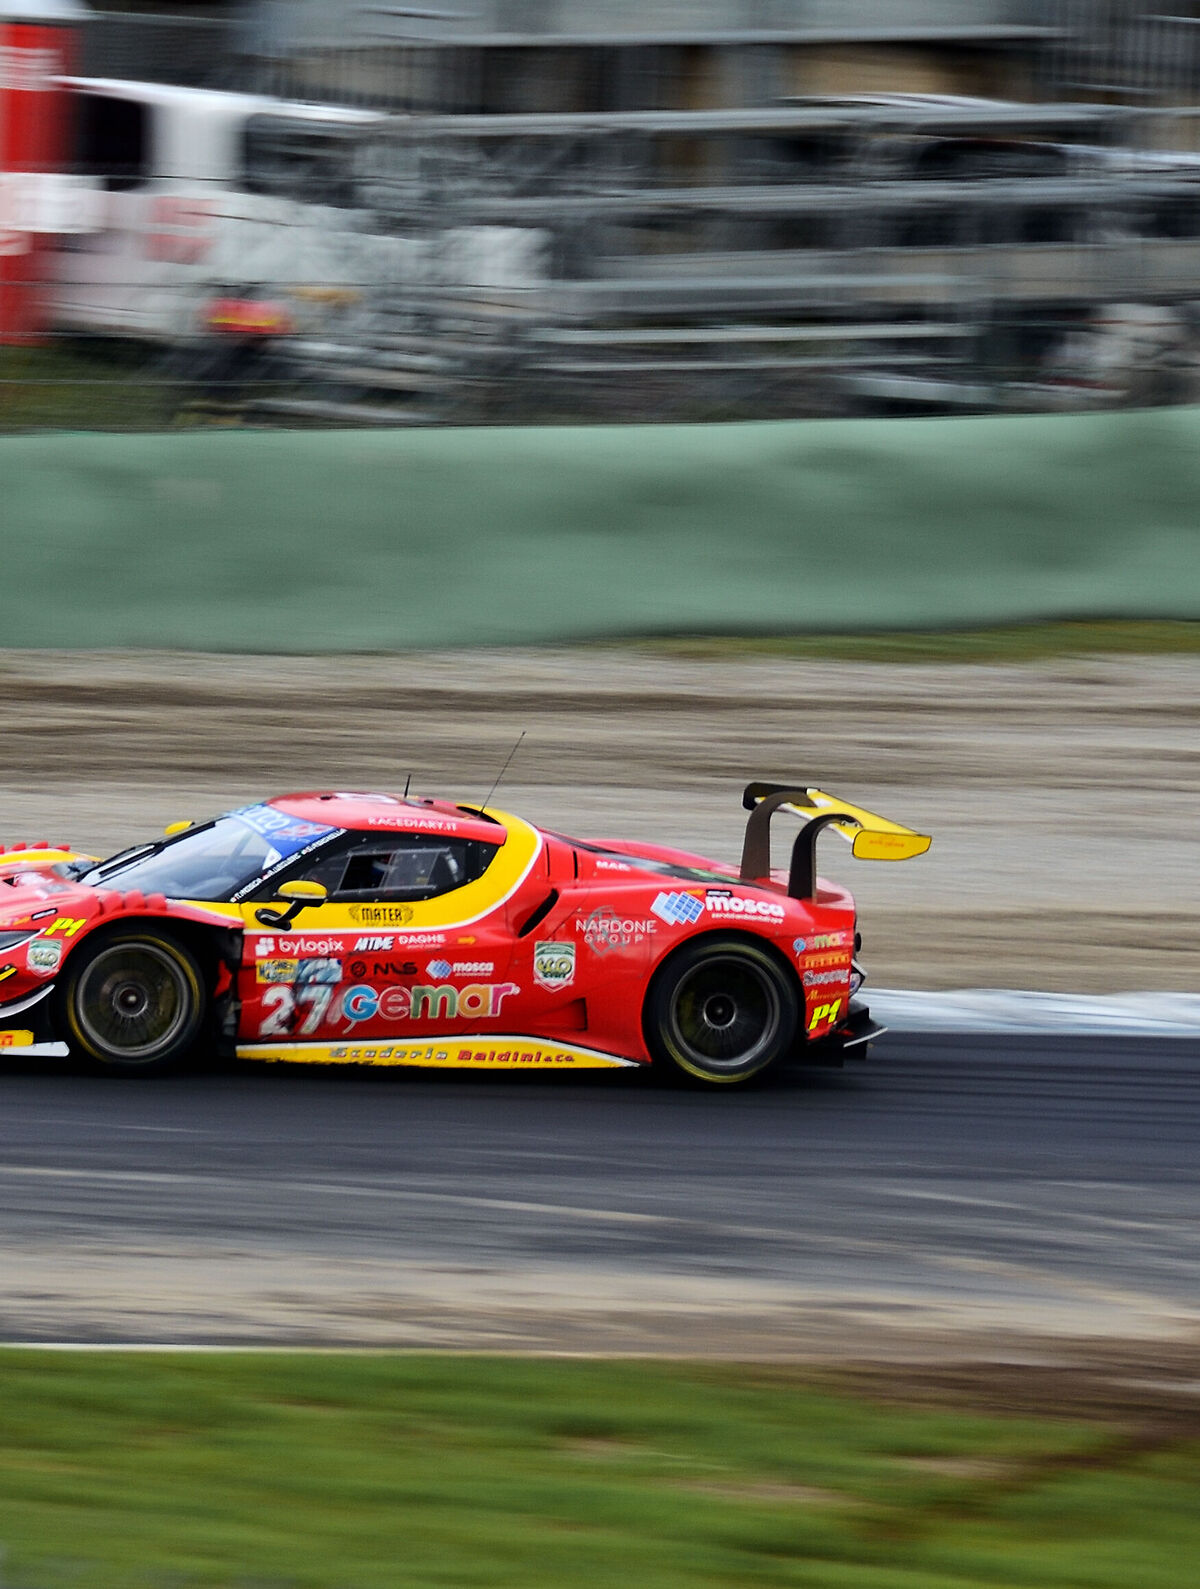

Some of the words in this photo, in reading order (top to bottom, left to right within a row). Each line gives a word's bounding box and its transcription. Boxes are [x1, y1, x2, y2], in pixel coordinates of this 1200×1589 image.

[362, 907, 402, 920] MATER
[705, 896, 785, 918] mosca
[575, 919, 658, 934] NARDONE
[279, 938, 344, 955] bylogix
[584, 933, 644, 945] GROUP
[453, 962, 494, 973] mosca
[259, 985, 334, 1035] 27
[343, 982, 521, 1034] Gemar
[330, 1047, 448, 1060] Scuderia
[458, 1050, 541, 1062] Baldini
